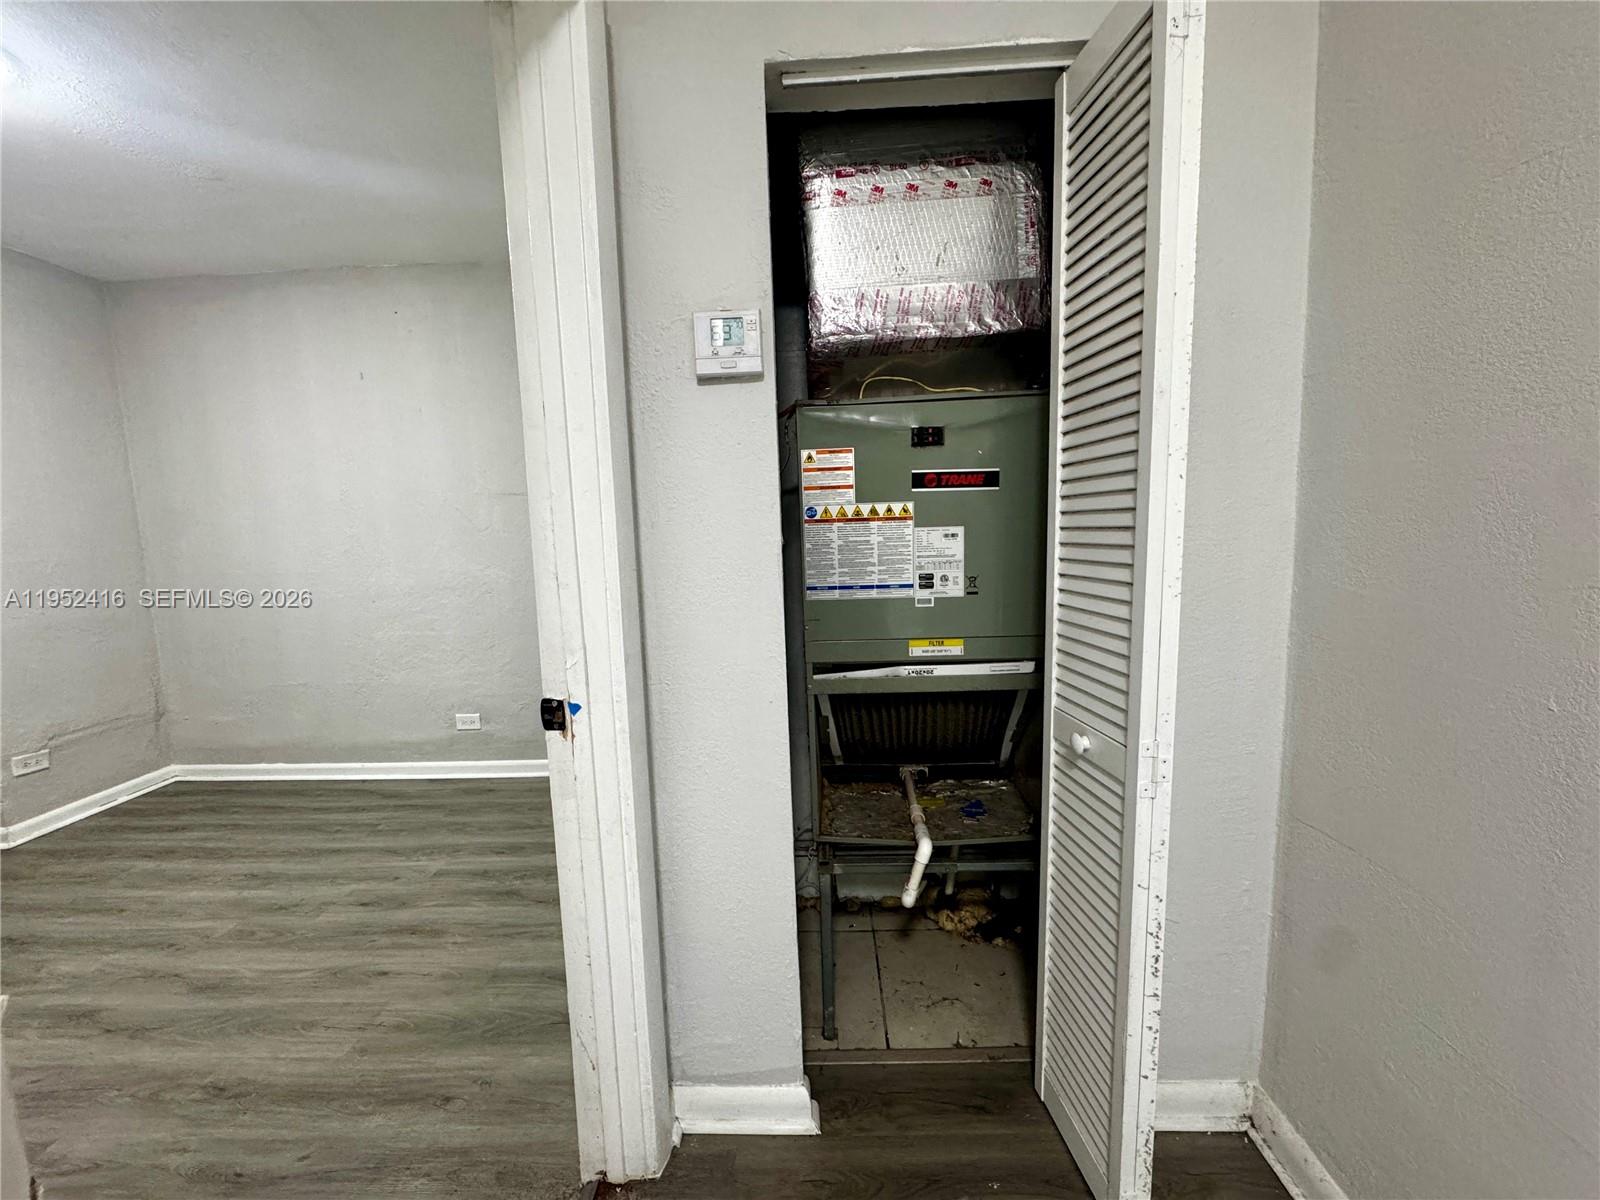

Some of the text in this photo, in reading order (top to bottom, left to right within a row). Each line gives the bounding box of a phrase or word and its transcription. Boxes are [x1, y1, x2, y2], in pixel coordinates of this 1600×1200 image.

[905, 183, 919, 193] 3M
[943, 180, 958, 190] 3M
[979, 178, 993, 188] 3M
[833, 188, 847, 199] 3M
[871, 184, 884, 195] 3M
[940, 473, 986, 486] TRANE
